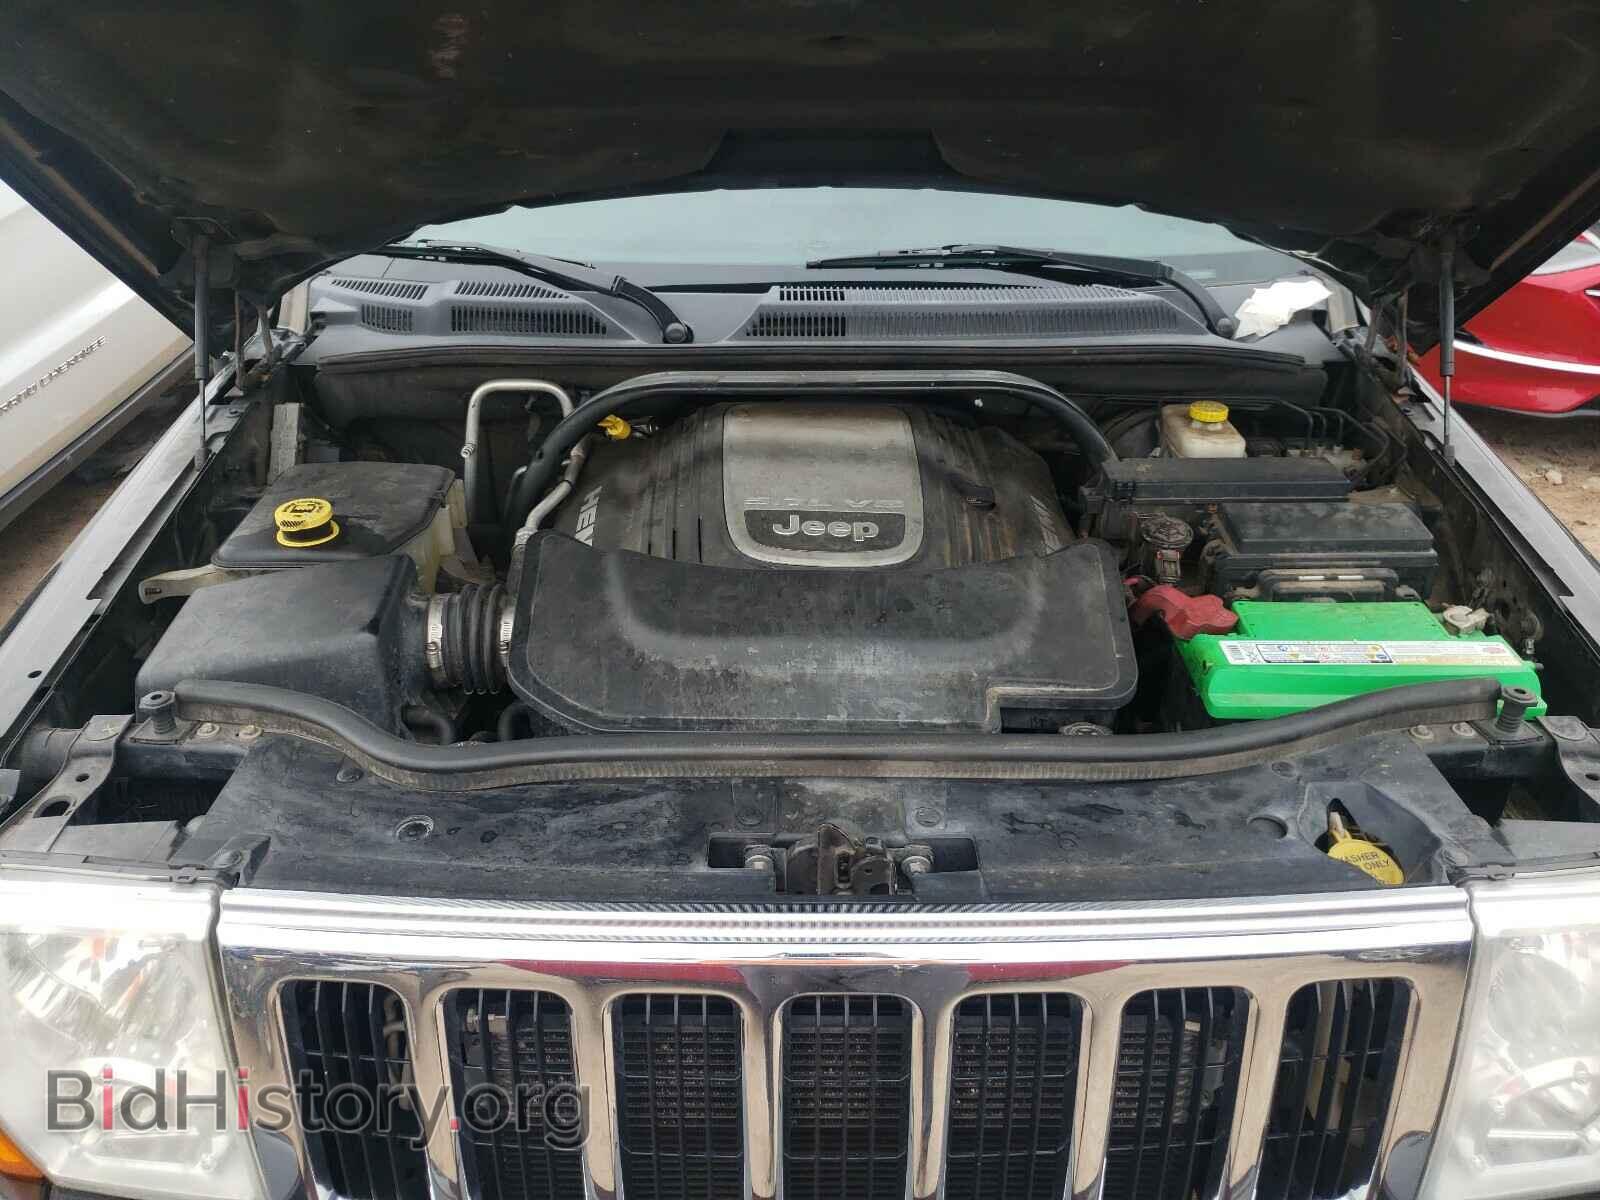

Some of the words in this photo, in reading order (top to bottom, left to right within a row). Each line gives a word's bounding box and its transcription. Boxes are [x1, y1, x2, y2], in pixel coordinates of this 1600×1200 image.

[772, 514, 880, 542] Jeep
[1342, 851, 1378, 866] ASHER
[1363, 858, 1389, 871] ONLY
